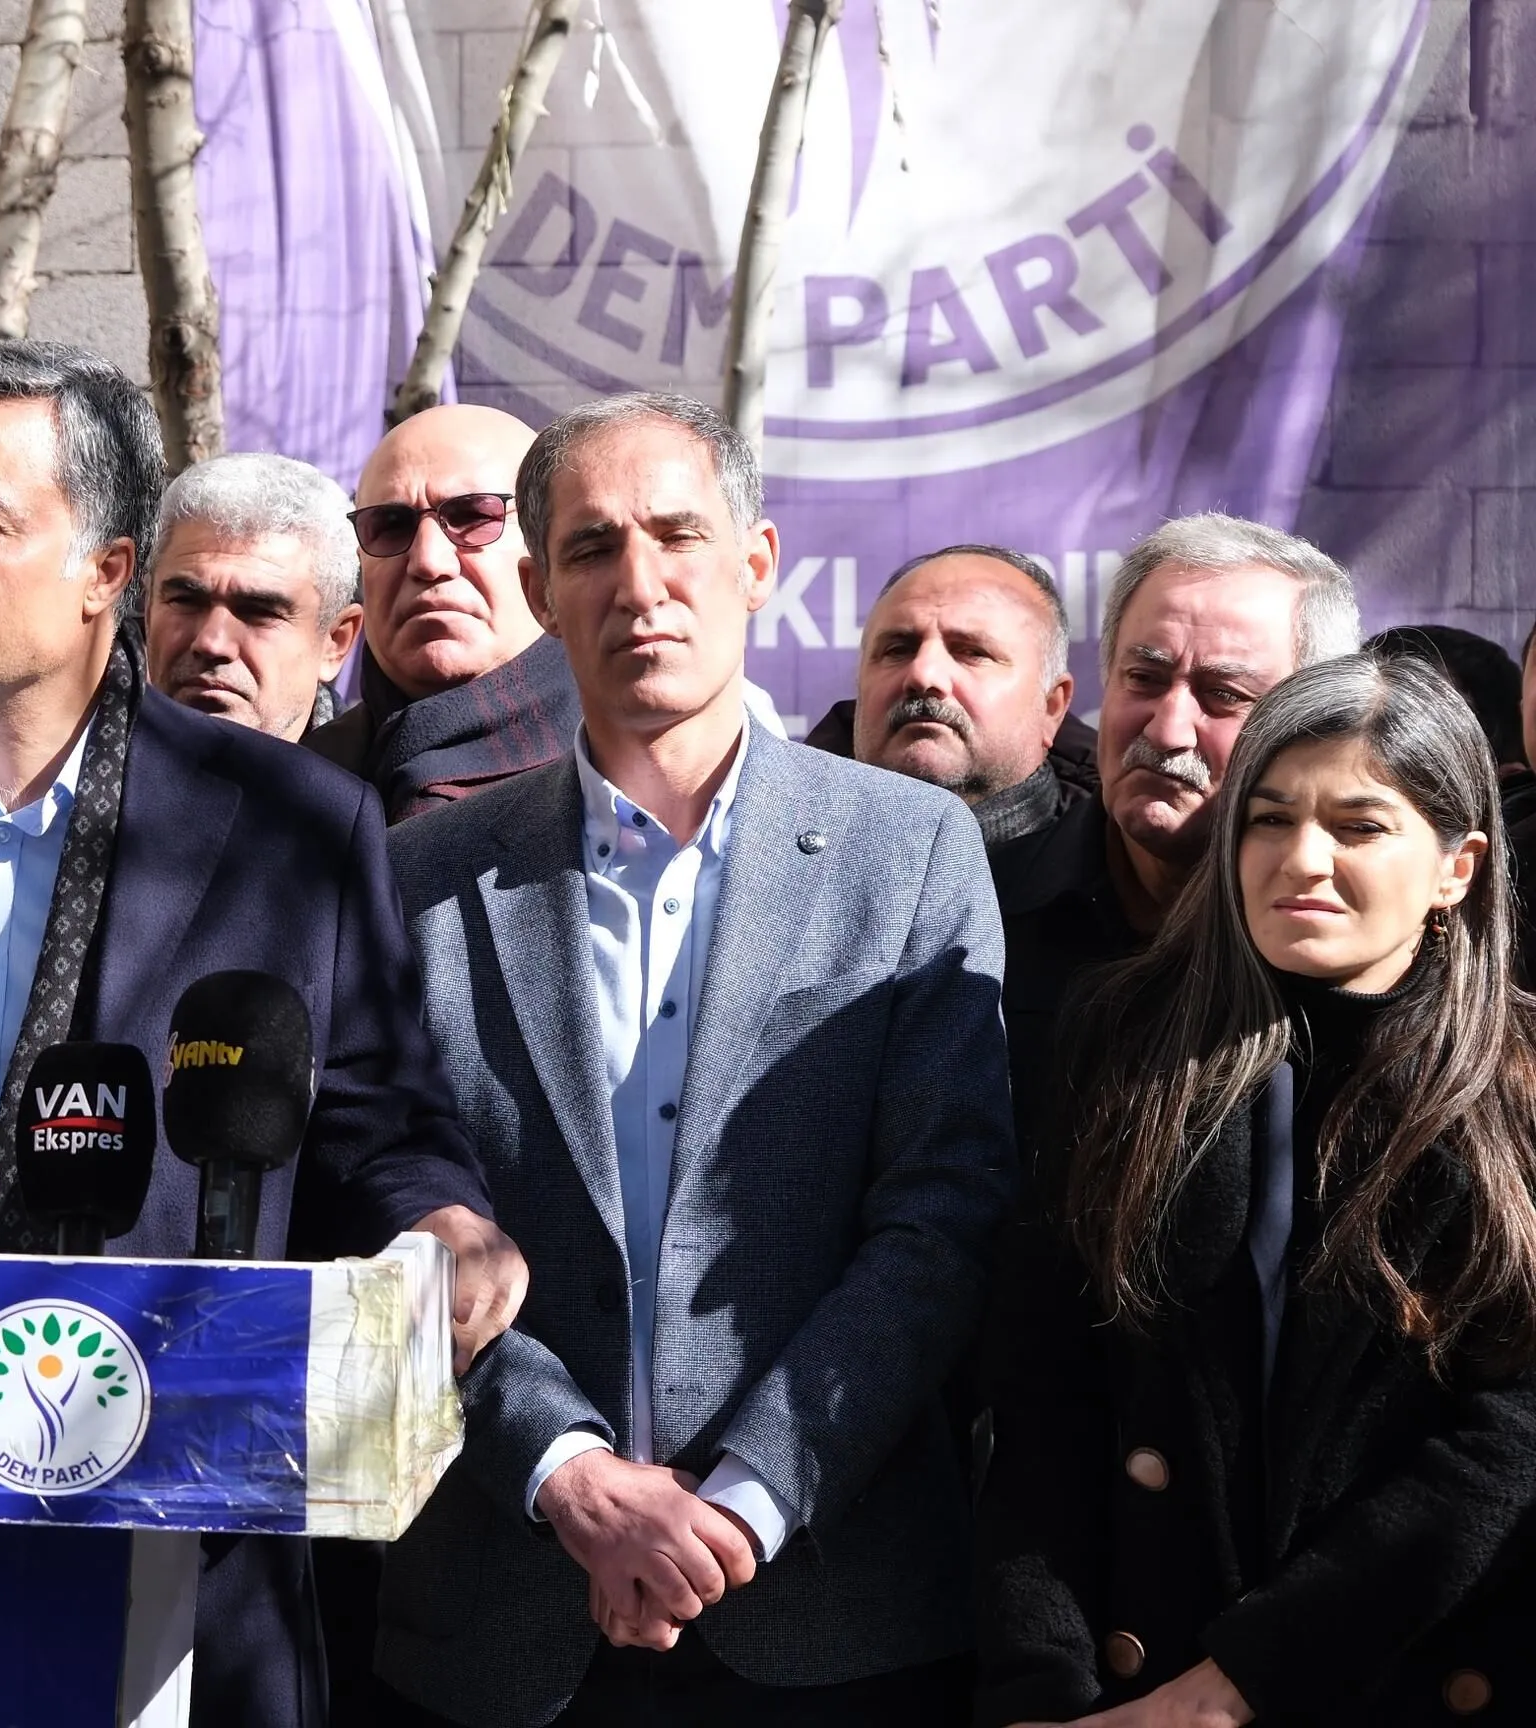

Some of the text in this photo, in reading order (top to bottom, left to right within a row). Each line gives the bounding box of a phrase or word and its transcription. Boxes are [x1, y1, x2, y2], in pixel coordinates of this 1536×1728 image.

[489, 121, 1234, 390] DEM PARTİ
[35, 1082, 127, 1119] VAN
[33, 1128, 124, 1154] Ekspres
[41, 1451, 104, 1484] PARTİ
